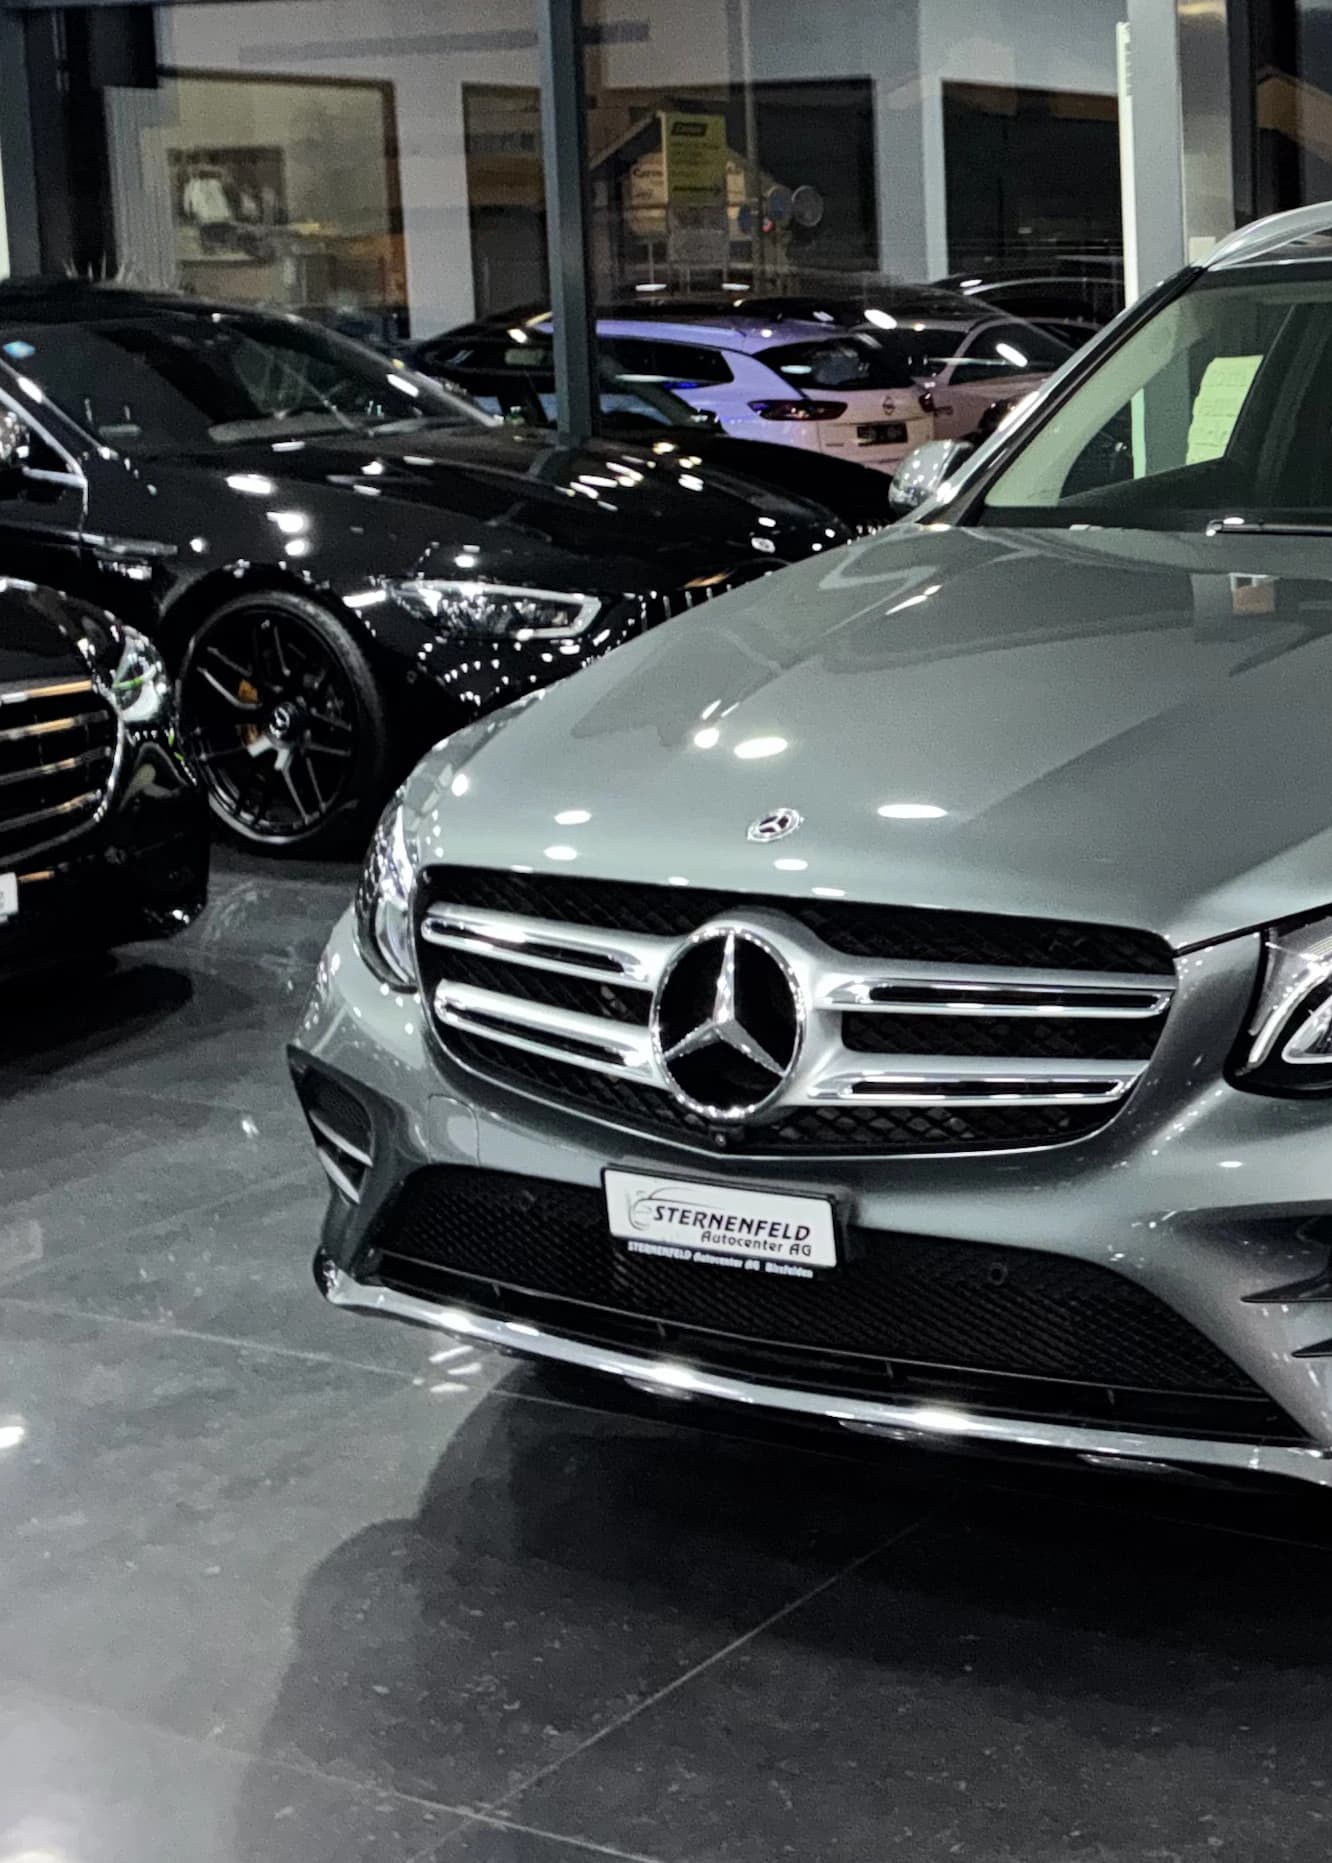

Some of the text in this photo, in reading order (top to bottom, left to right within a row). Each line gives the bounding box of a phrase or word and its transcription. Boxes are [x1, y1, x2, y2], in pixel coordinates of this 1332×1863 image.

[653, 1205, 811, 1241] STERNENFELD
[627, 1240, 692, 1260] STERNENFELD
[700, 1230, 812, 1257] Autocenter AG
